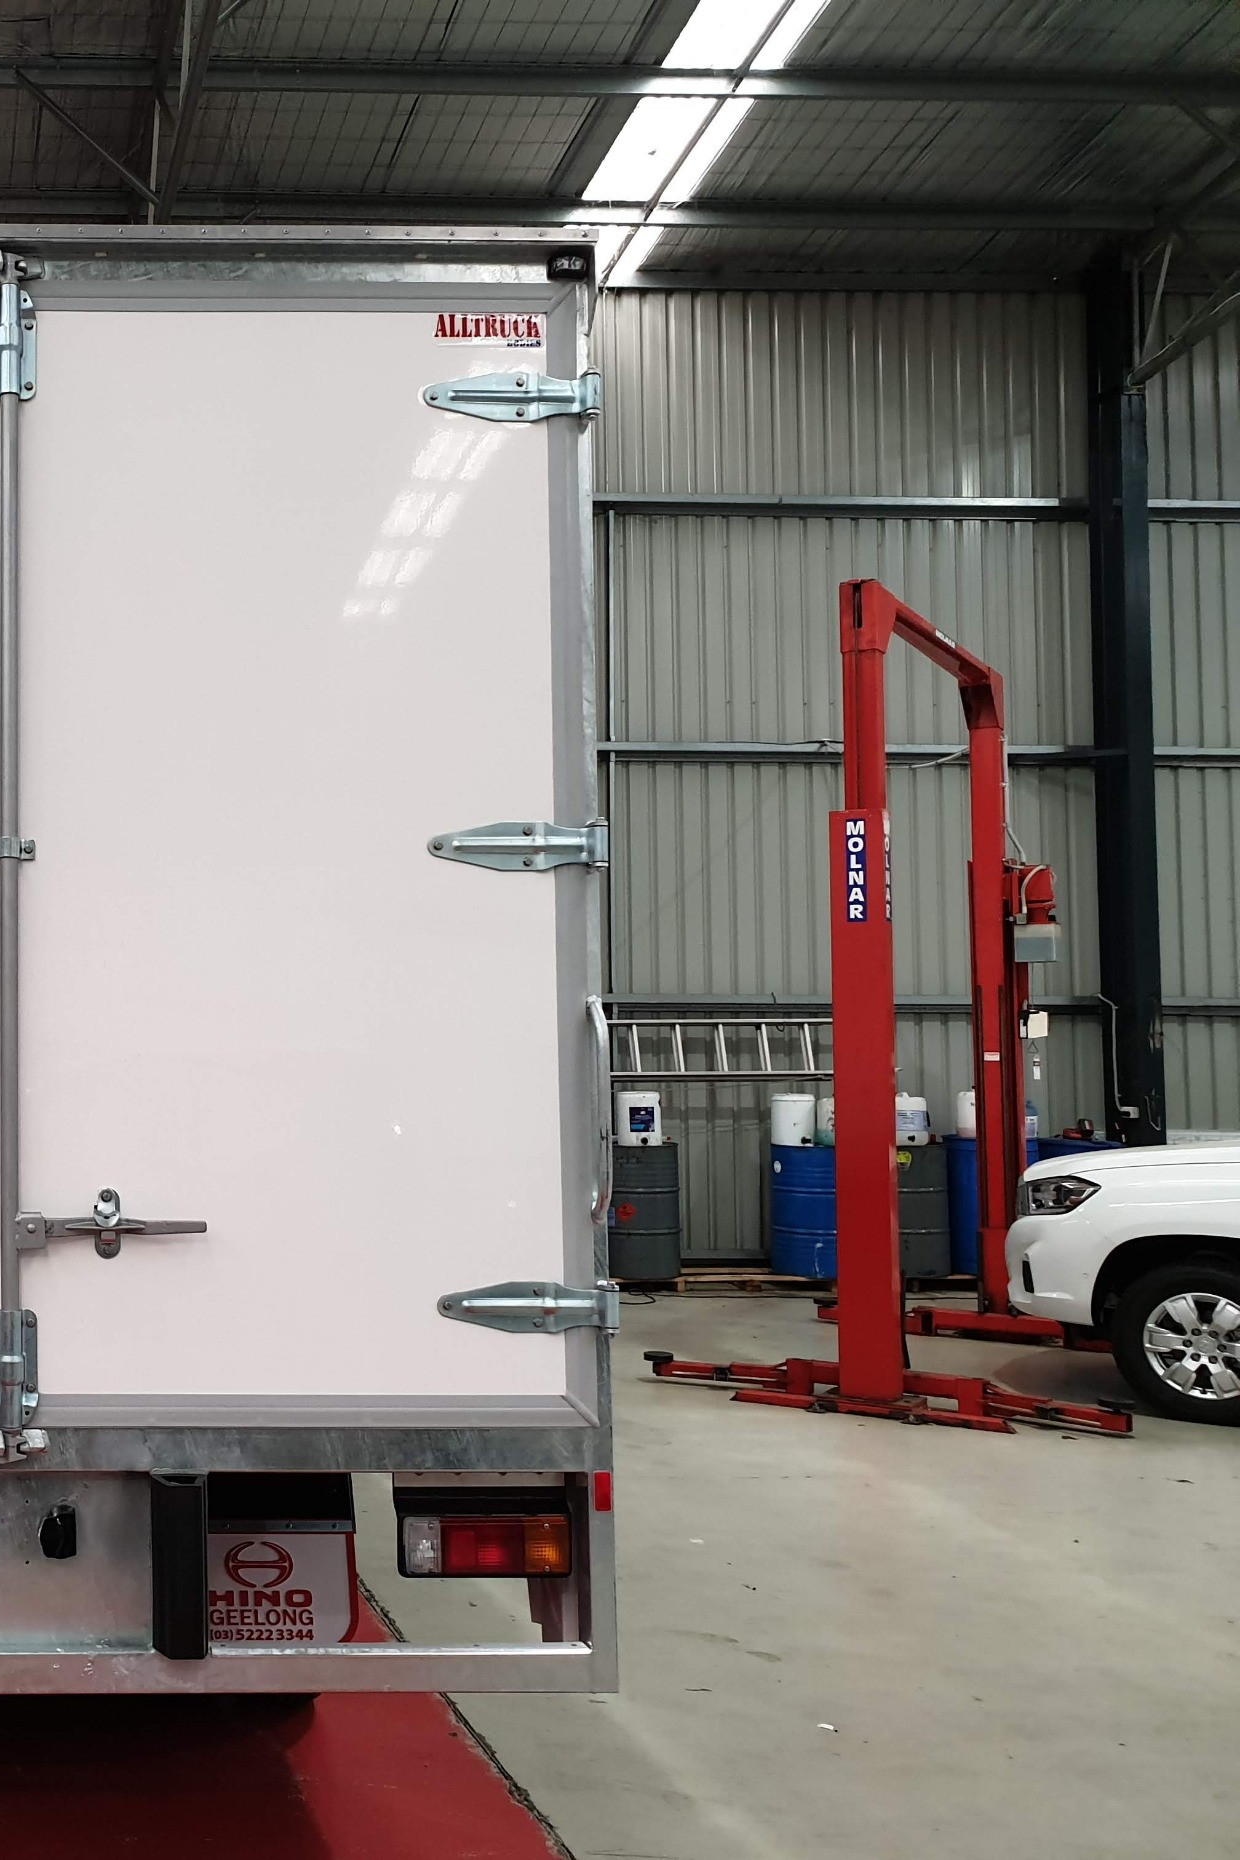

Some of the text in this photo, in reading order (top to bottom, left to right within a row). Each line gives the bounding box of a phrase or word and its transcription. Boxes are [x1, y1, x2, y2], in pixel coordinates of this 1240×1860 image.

[434, 313, 541, 338] ALLTRUCK
[846, 820, 865, 919] MOLNAR
[209, 1589, 313, 1608] HINO
[210, 1609, 314, 1626] GEELONG
